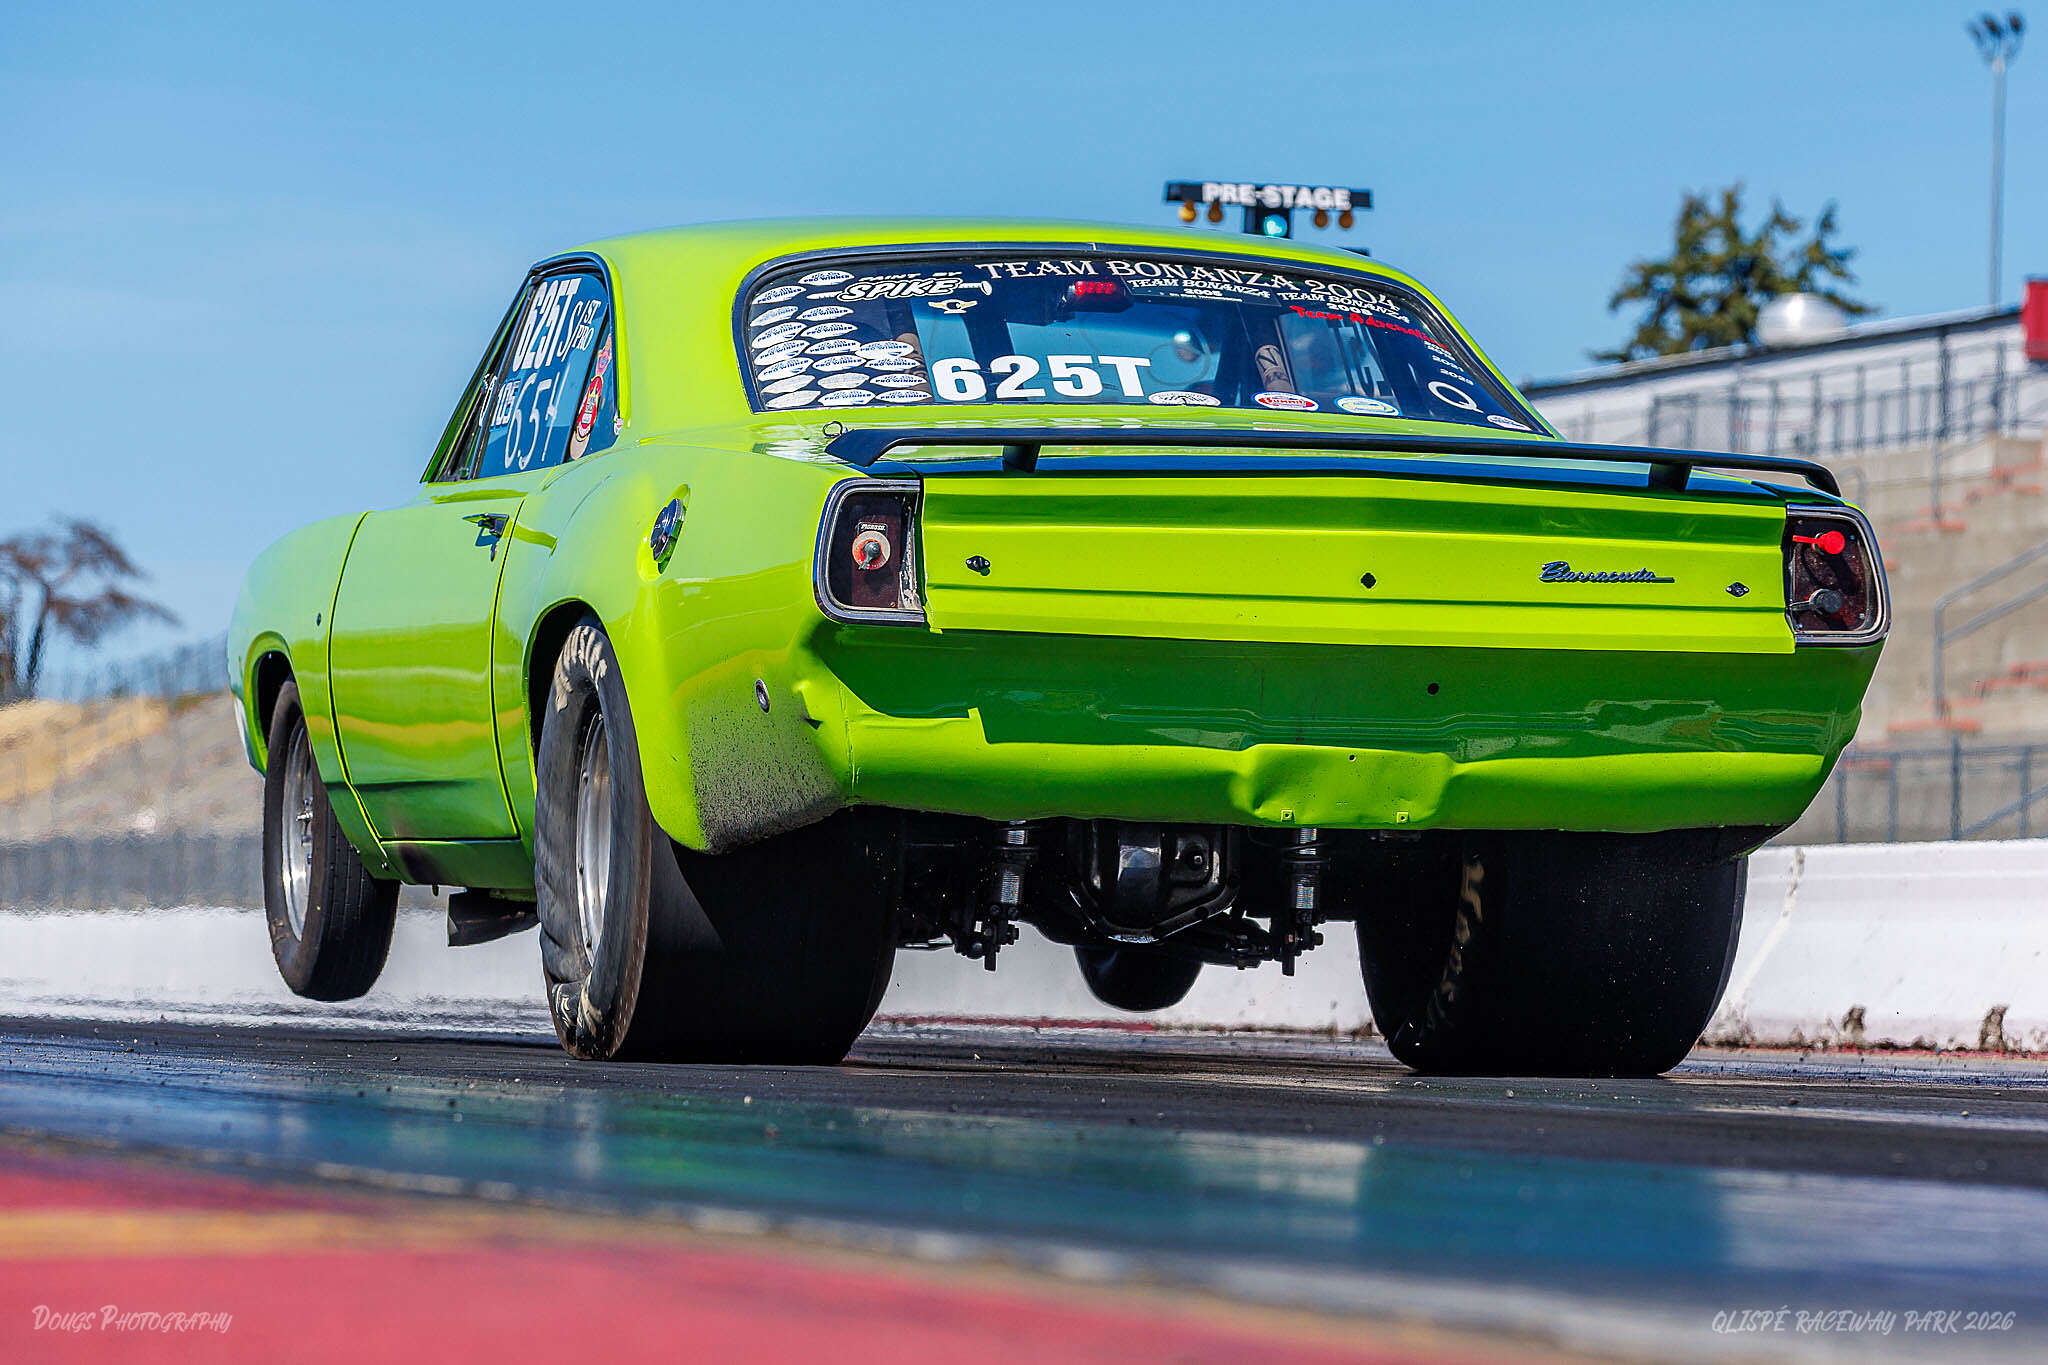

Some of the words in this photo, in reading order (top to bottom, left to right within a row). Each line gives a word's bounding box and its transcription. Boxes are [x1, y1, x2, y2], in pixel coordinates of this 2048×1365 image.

[1201, 182, 1352, 210] PRE-STAGE
[838, 278, 963, 301] SPIKE
[975, 260, 1099, 279] TEAM
[1105, 260, 1301, 290] BONANZA
[1304, 279, 1401, 312] 2004
[1127, 279, 1179, 288] TEAM
[1182, 279, 1271, 299] BONANZA
[1276, 292, 1326, 302] TEAM
[1328, 295, 1411, 324] BONANZA
[1289, 305, 1343, 320] Team
[512, 277, 582, 372] 625T
[931, 355, 1151, 401] 625T
[1539, 560, 1675, 583] Barracuda
